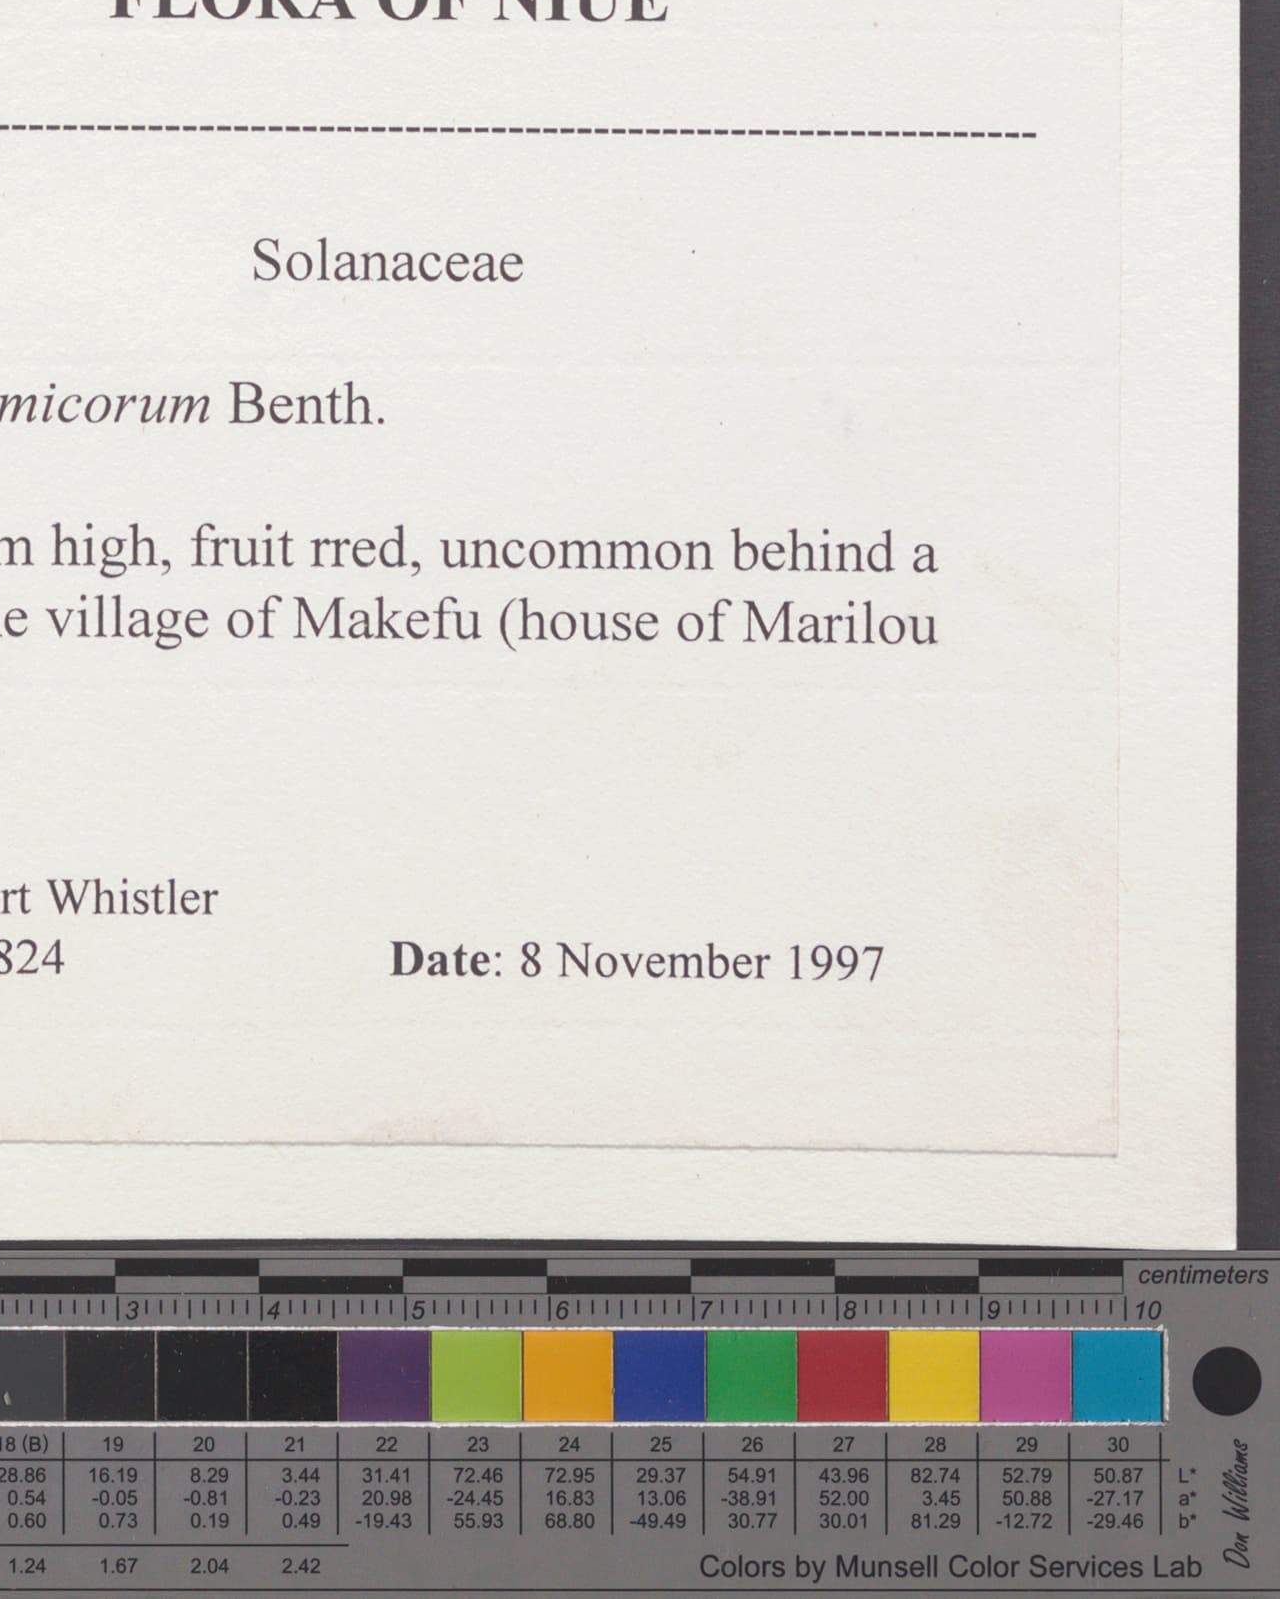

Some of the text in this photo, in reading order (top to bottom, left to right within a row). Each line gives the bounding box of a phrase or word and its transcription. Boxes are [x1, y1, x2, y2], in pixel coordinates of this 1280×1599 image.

[253, 236, 524, 283] Solanaceae
[228, 380, 385, 425] Benth.
[51, 522, 171, 579] high,
[190, 522, 294, 568] fruit
[310, 524, 421, 577] rred,
[439, 539, 714, 571] uncommon
[730, 527, 895, 573] behind
[912, 543, 939, 574] a
[45, 594, 209, 651] village
[227, 594, 283, 639] of
[293, 595, 482, 640] Makefu
[499, 596, 659, 652] (house
[677, 598, 733, 643] of
[743, 600, 938, 646] Marilou
[46, 877, 219, 916] Whistler
[390, 940, 884, 982] Date: 8 November 1997
[1138, 1264, 1270, 1285] centimeters
[124, 1300, 140, 1321] 3
[266, 1300, 281, 1321] 4
[411, 1300, 426, 1321] 5
[555, 1300, 570, 1321] 6
[700, 1300, 714, 1320] 7
[843, 1299, 857, 1321] 8
[987, 1300, 1001, 1320] 9
[1135, 1300, 1162, 1321] 10
[22, 1433, 49, 1455] (B)
[103, 1435, 124, 1453] 19
[192, 1435, 216, 1453] 20
[284, 1435, 304, 1453] 21
[375, 1435, 398, 1453] 22
[467, 1435, 490, 1453] 23
[558, 1436, 581, 1453] 24
[649, 1435, 673, 1453] 25
[741, 1436, 764, 1453] 26
[832, 1435, 856, 1453] 27
[924, 1436, 947, 1453] 28
[1015, 1436, 1038, 1453] 29
[1107, 1436, 1130, 1453] 30
[1221, 1438, 1251, 1569] Don Williams
[8, 1557, 47, 1574] 1.24
[100, 1557, 139, 1574] 1.67
[190, 1557, 230, 1575] 2.04
[281, 1557, 321, 1575] 2.42
[699, 1554, 1203, 1584] Colors by Munsell Color Services Lab
